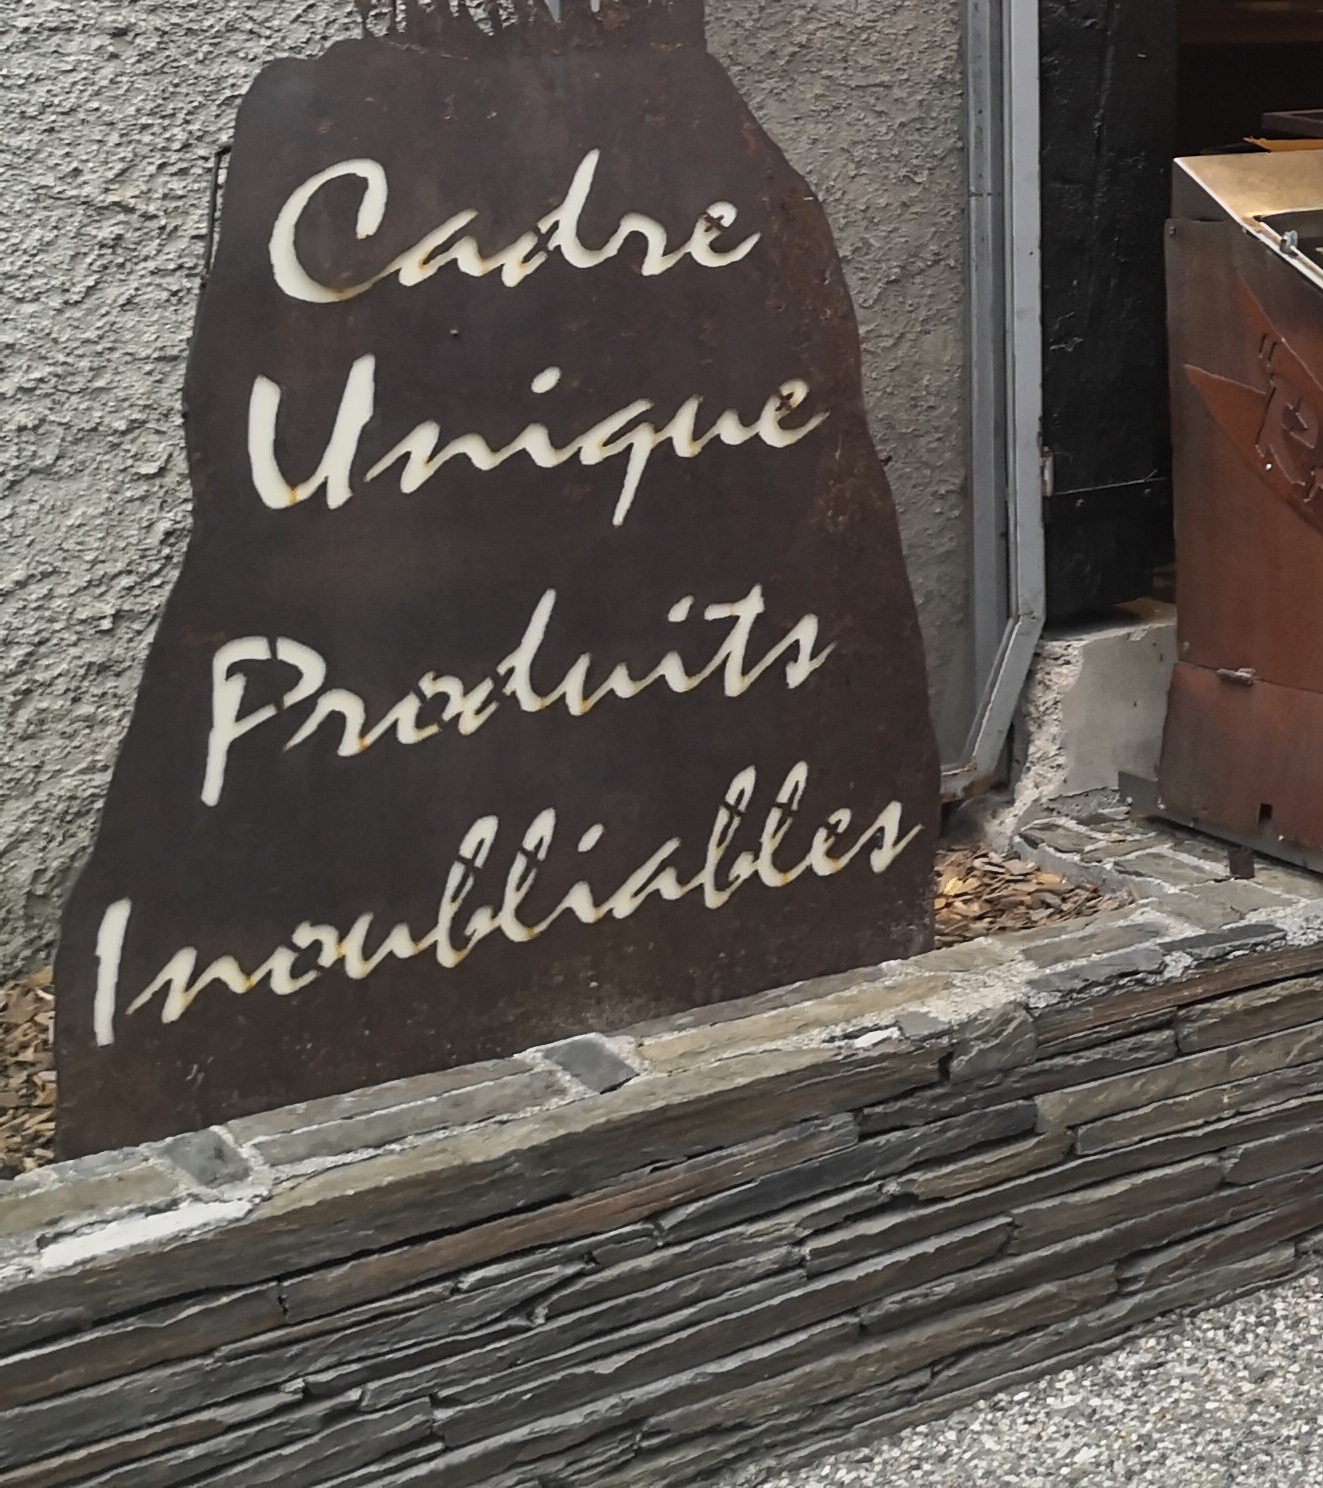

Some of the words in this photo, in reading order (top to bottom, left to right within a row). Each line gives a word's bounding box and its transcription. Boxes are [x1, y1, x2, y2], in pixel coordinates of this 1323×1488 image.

[269, 149, 762, 304] Cadre
[247, 353, 830, 526] Unique
[200, 583, 835, 806] Produits
[94, 761, 926, 1047] Inoubliables
